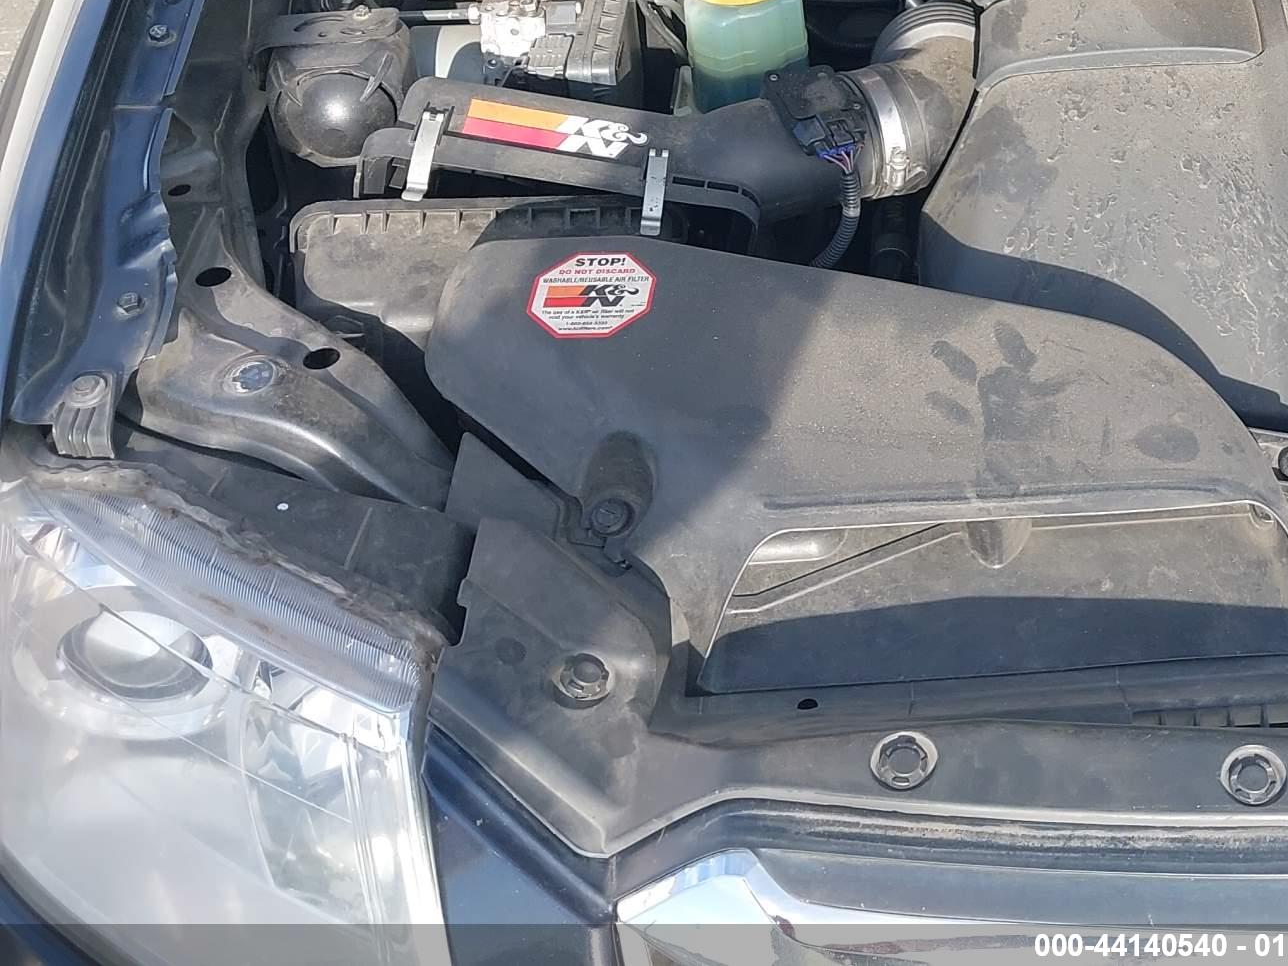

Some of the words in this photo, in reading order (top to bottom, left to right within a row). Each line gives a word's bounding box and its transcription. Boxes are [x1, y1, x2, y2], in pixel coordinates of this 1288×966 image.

[555, 115, 650, 160] K&N
[575, 257, 626, 267] STOP!
[578, 284, 640, 308] K&N
